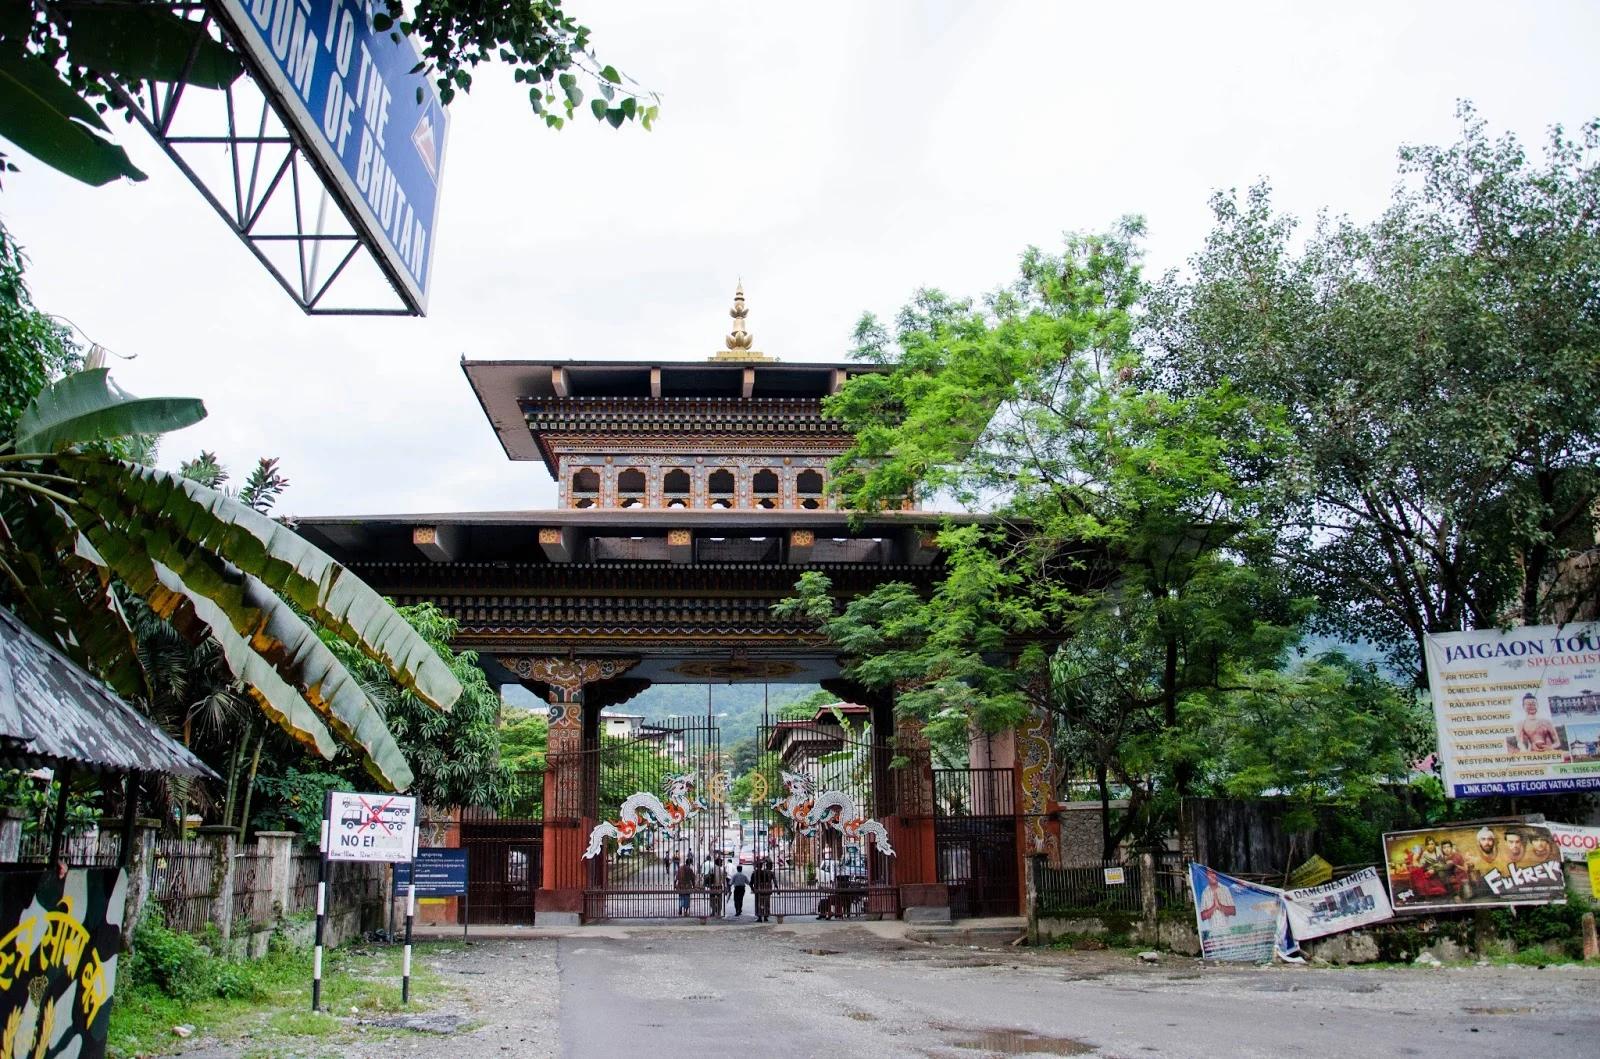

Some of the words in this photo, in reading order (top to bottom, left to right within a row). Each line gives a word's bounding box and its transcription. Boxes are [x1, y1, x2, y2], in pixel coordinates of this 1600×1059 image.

[356, 40, 391, 151] THE
[324, 71, 355, 158] OF
[356, 124, 426, 283] BHUTAN
[1444, 639, 1544, 664] JAIGAON
[1458, 672, 1488, 680] TICKETS
[1489, 683, 1541, 692] INTERNATIONAL
[1476, 713, 1511, 721] BOOKING
[1508, 769, 1545, 777] SERVICES
[1463, 785, 1480, 794] LINK
[1507, 783, 1520, 792] 1ST
[1521, 781, 1547, 791] FLOOR
[1548, 780, 1575, 789] VATIKA
[340, 834, 359, 847] NO
[1293, 881, 1343, 899] DAMCHEN
[1345, 868, 1376, 885] IMPEX
